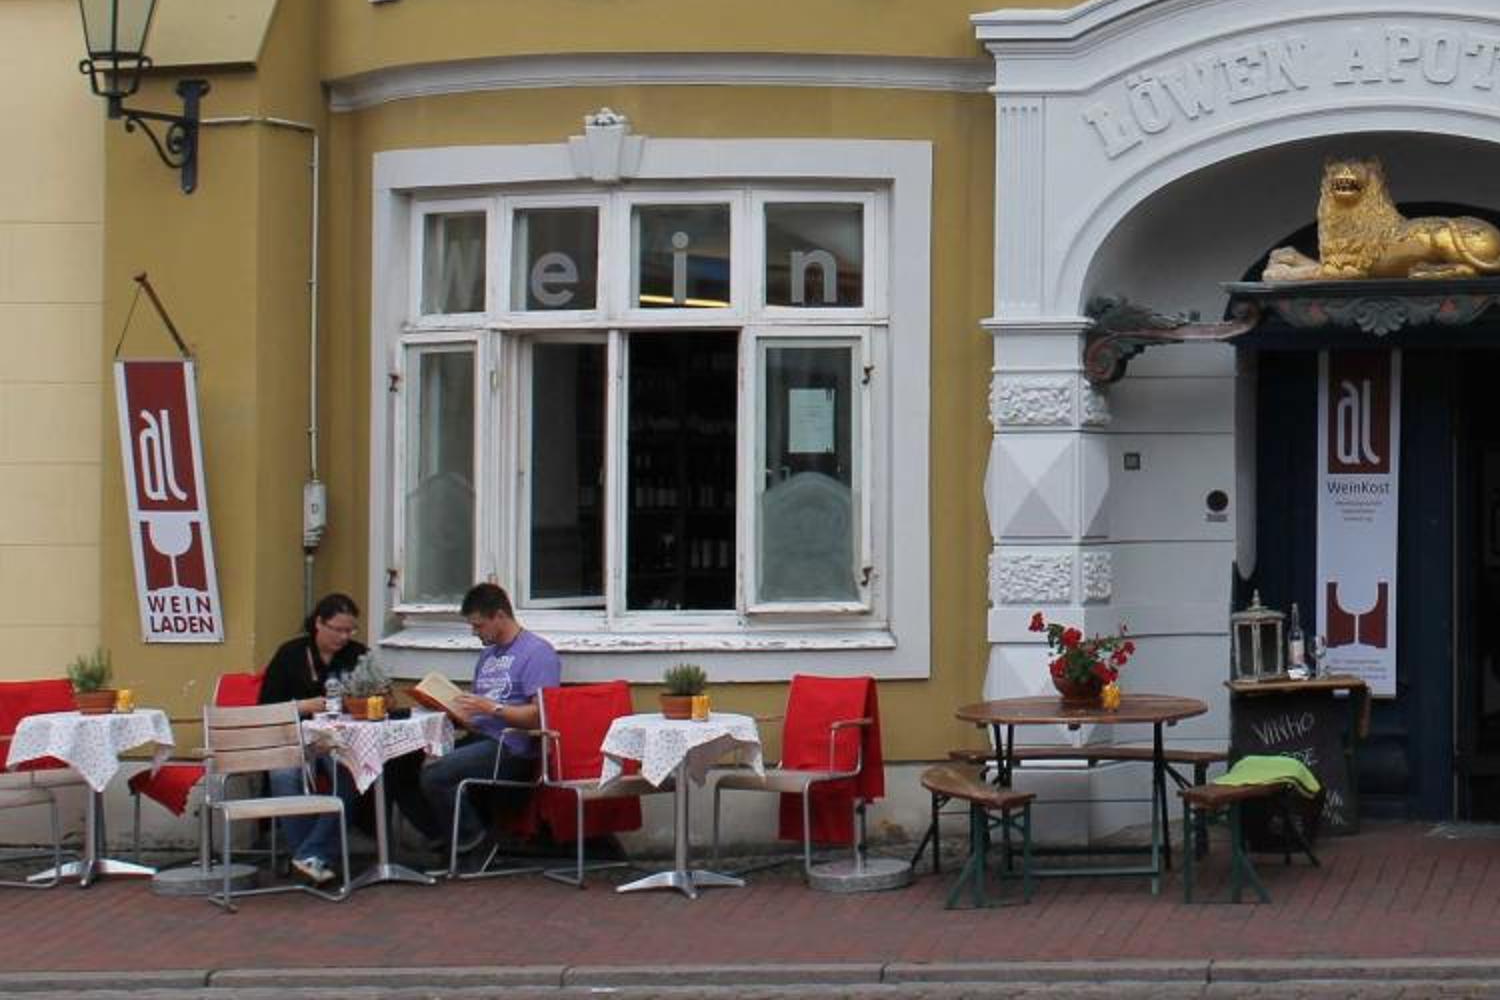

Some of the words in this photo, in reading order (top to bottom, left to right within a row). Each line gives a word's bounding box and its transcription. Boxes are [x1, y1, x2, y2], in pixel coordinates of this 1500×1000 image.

[1082, 37, 1310, 160] LÖWEN
[148, 596, 211, 614] WEIN
[150, 615, 215, 634] LADEN
